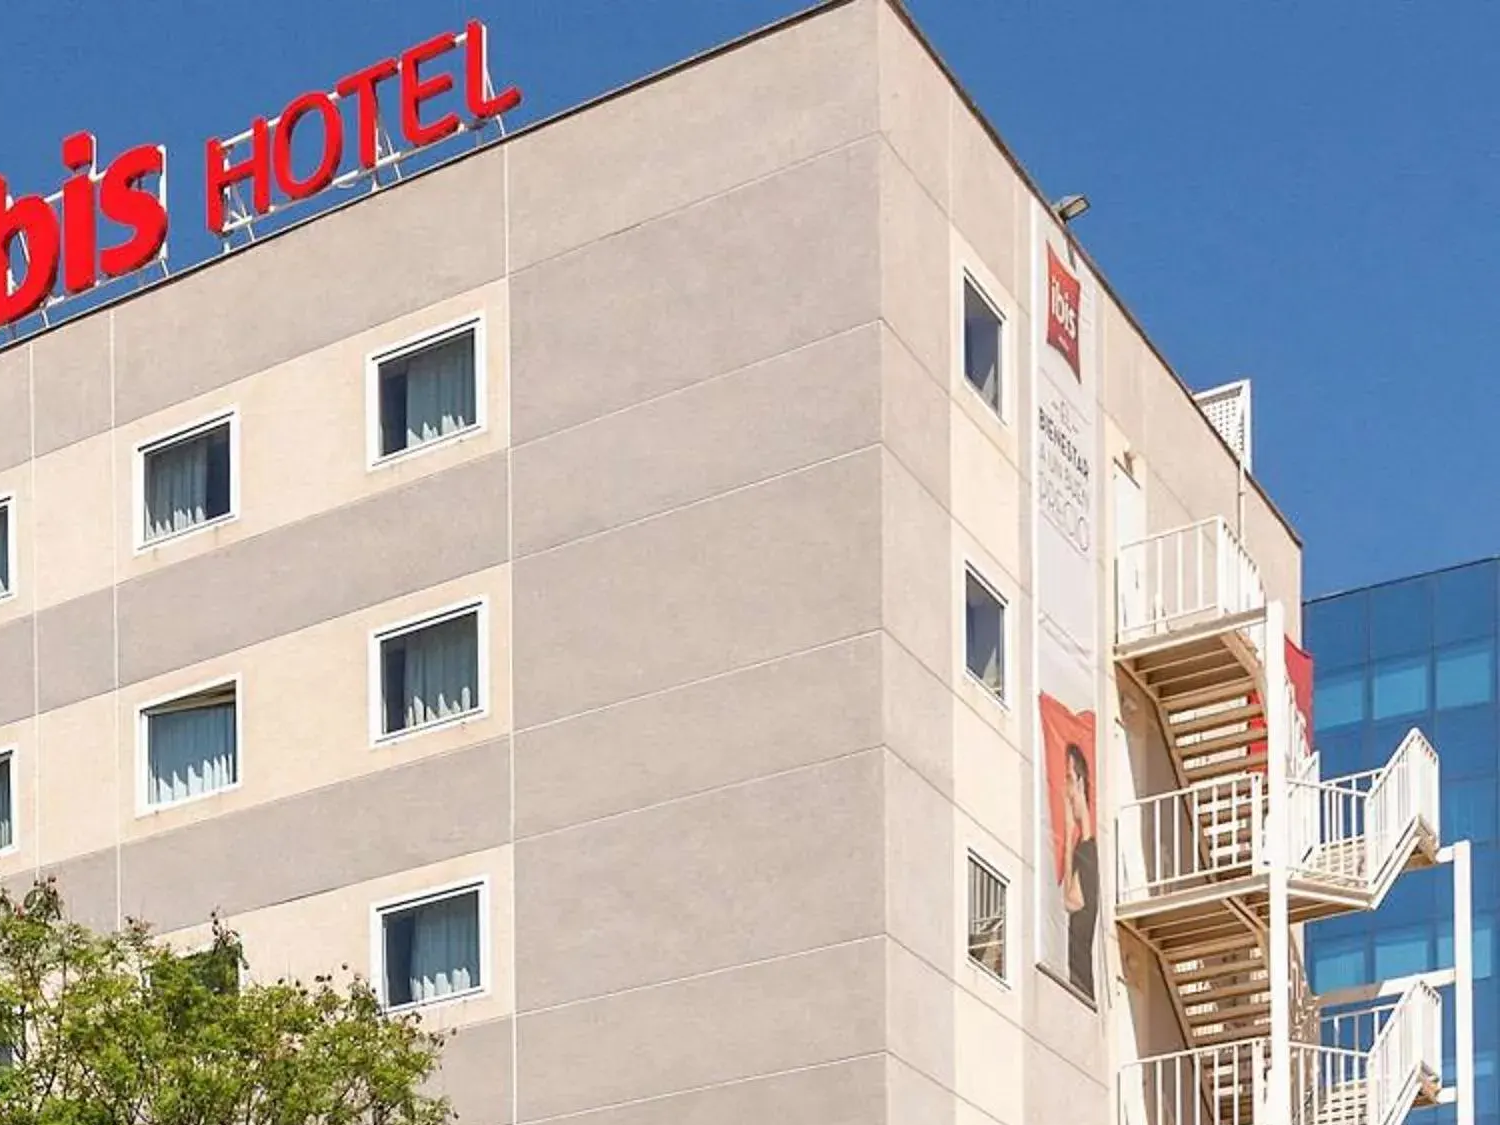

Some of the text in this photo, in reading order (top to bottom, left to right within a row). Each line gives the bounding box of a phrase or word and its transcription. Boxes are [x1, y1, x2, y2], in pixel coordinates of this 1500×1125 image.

[206, 19, 522, 235] HOTEL
[1051, 274, 1076, 340] ibis
[1038, 405, 1088, 478] BIENESTAR
